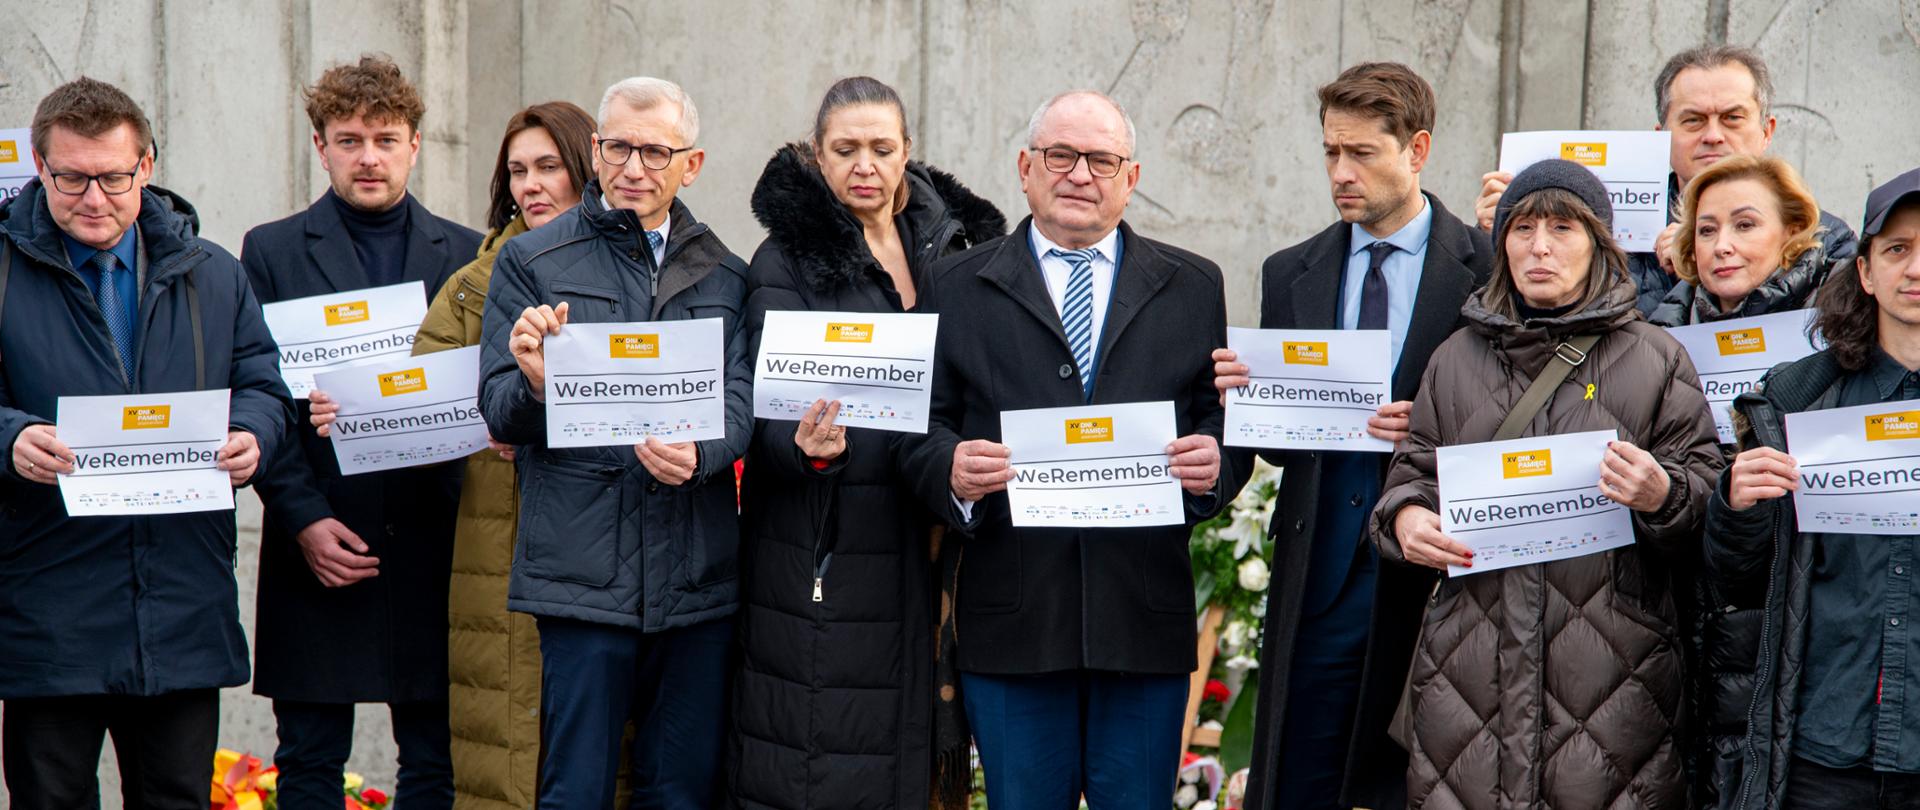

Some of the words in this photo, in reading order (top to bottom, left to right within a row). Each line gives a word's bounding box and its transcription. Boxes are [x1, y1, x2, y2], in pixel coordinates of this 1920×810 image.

[766, 358, 925, 383] WeRemember
[554, 378, 716, 398] WeRemember
[1236, 383, 1383, 405] WeRemember
[1704, 380, 1758, 395] Rem
[336, 406, 480, 435] WeRemembe
[1801, 467, 1920, 489] WeReme
[1449, 494, 1615, 525] WeRemembe
